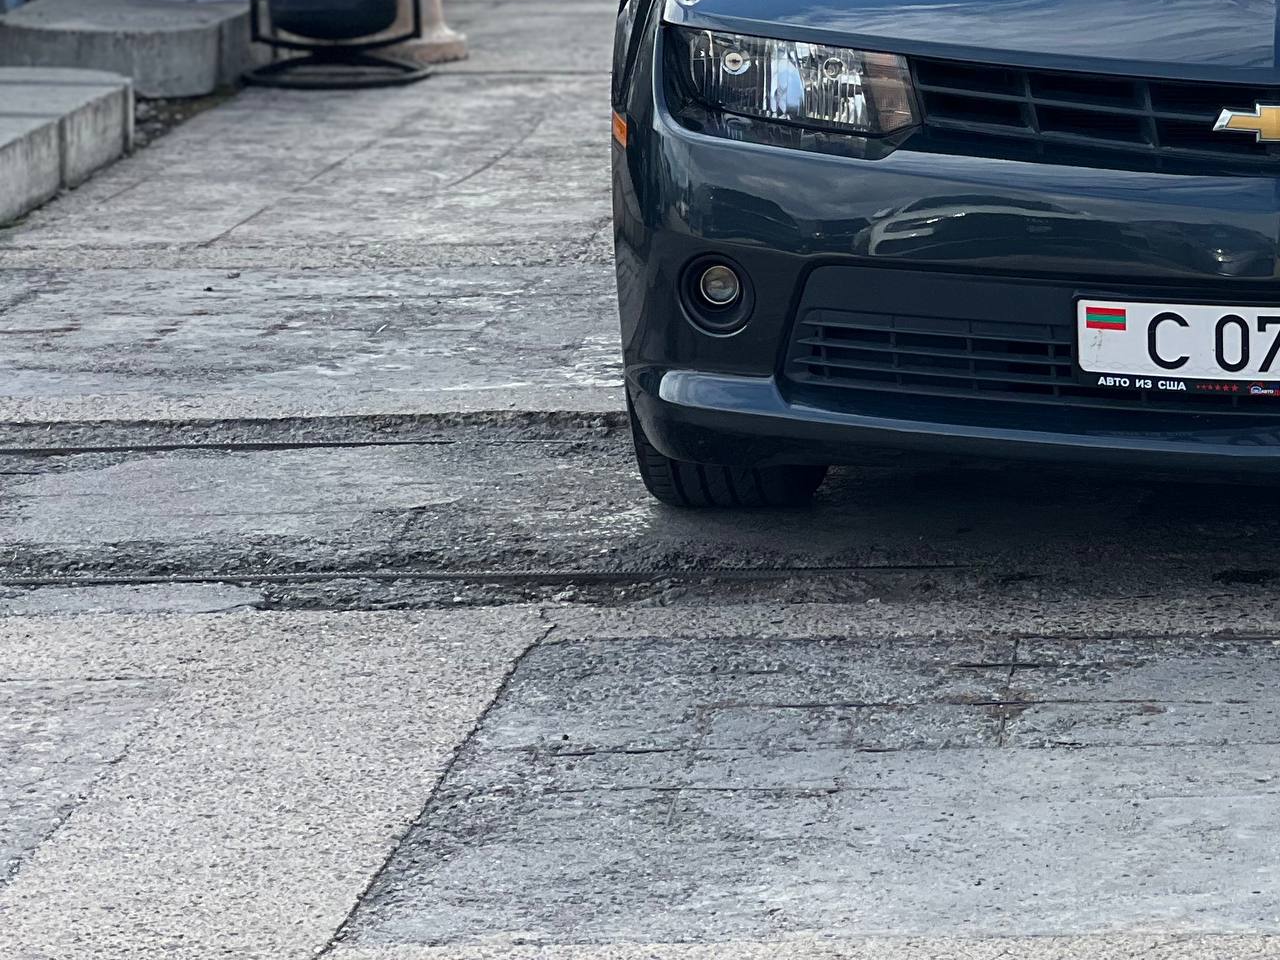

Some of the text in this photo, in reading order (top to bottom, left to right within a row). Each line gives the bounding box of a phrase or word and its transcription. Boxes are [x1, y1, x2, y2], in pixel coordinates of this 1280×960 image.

[1147, 311, 1190, 370] C
[1097, 376, 1187, 391] АВТО ИЗ США
